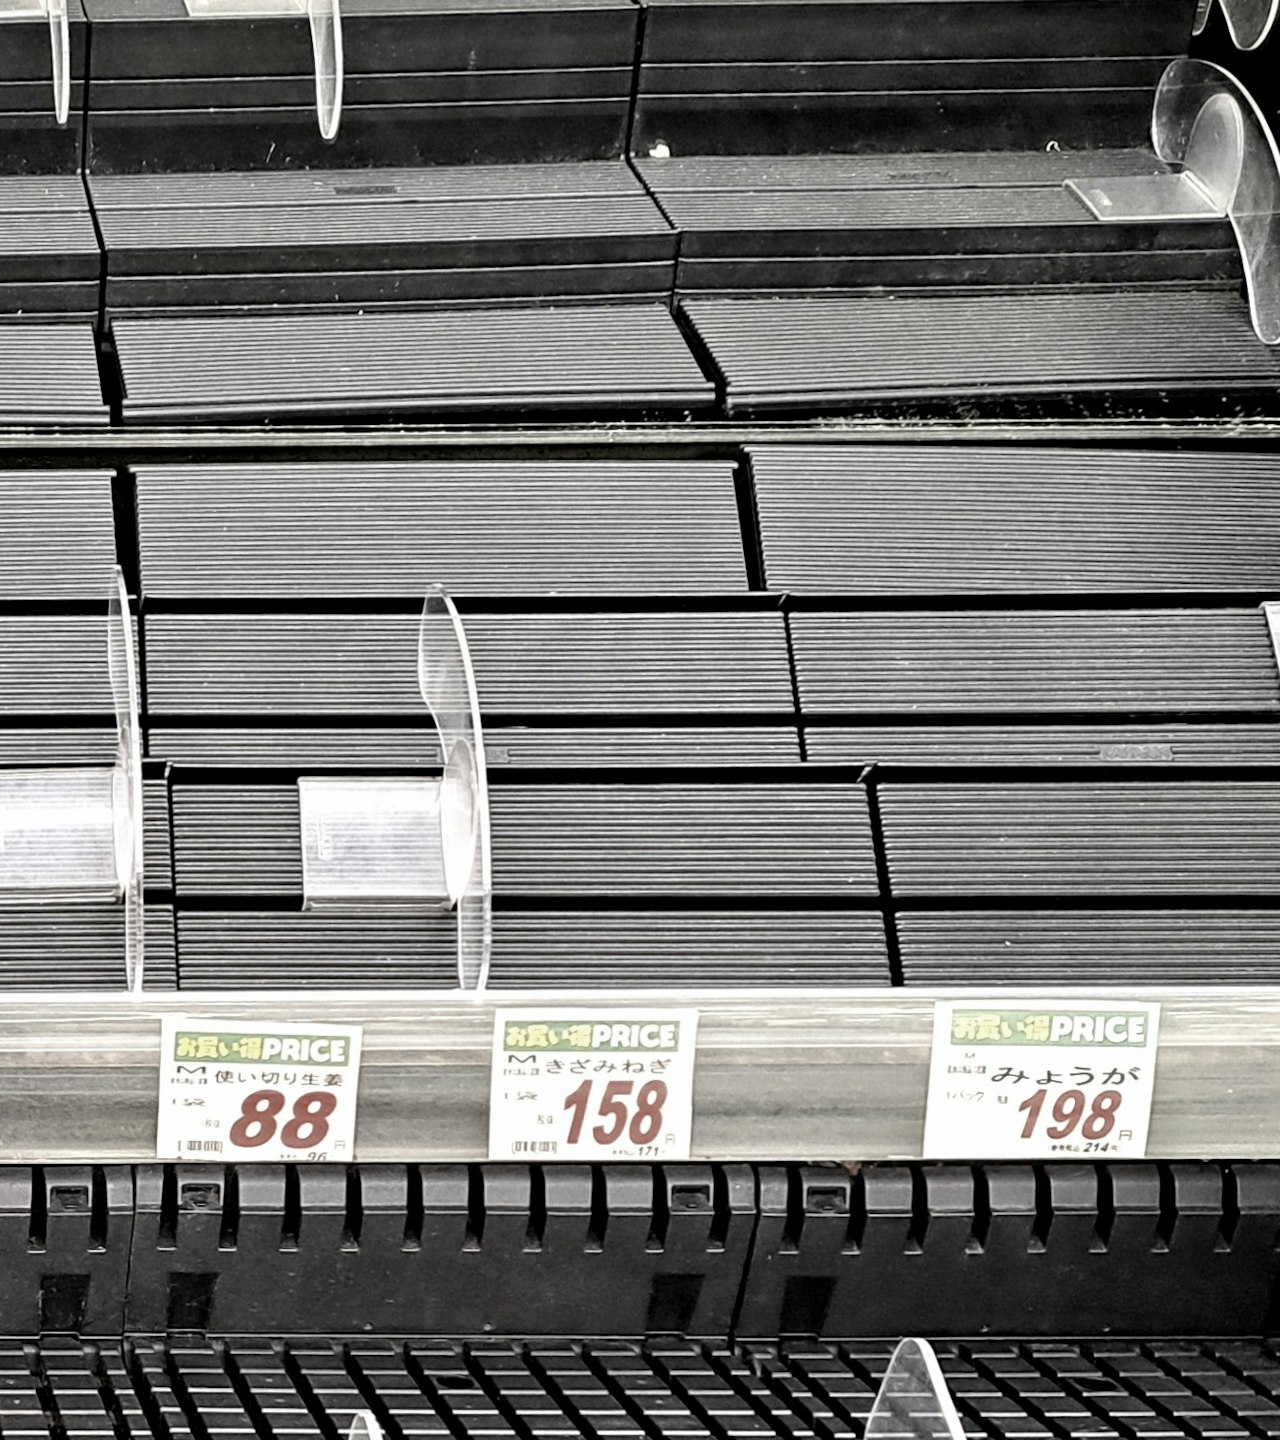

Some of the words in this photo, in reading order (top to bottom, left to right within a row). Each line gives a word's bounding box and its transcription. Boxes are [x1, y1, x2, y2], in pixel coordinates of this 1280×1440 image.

[215, 1070, 343, 1087] 使い切り生姜
[545, 1059, 671, 1074] きざみねぎ
[991, 1066, 1140, 1086] みょうが
[229, 1089, 338, 1149] 88
[564, 1079, 668, 1145] 158
[1018, 1089, 1122, 1140] 198
